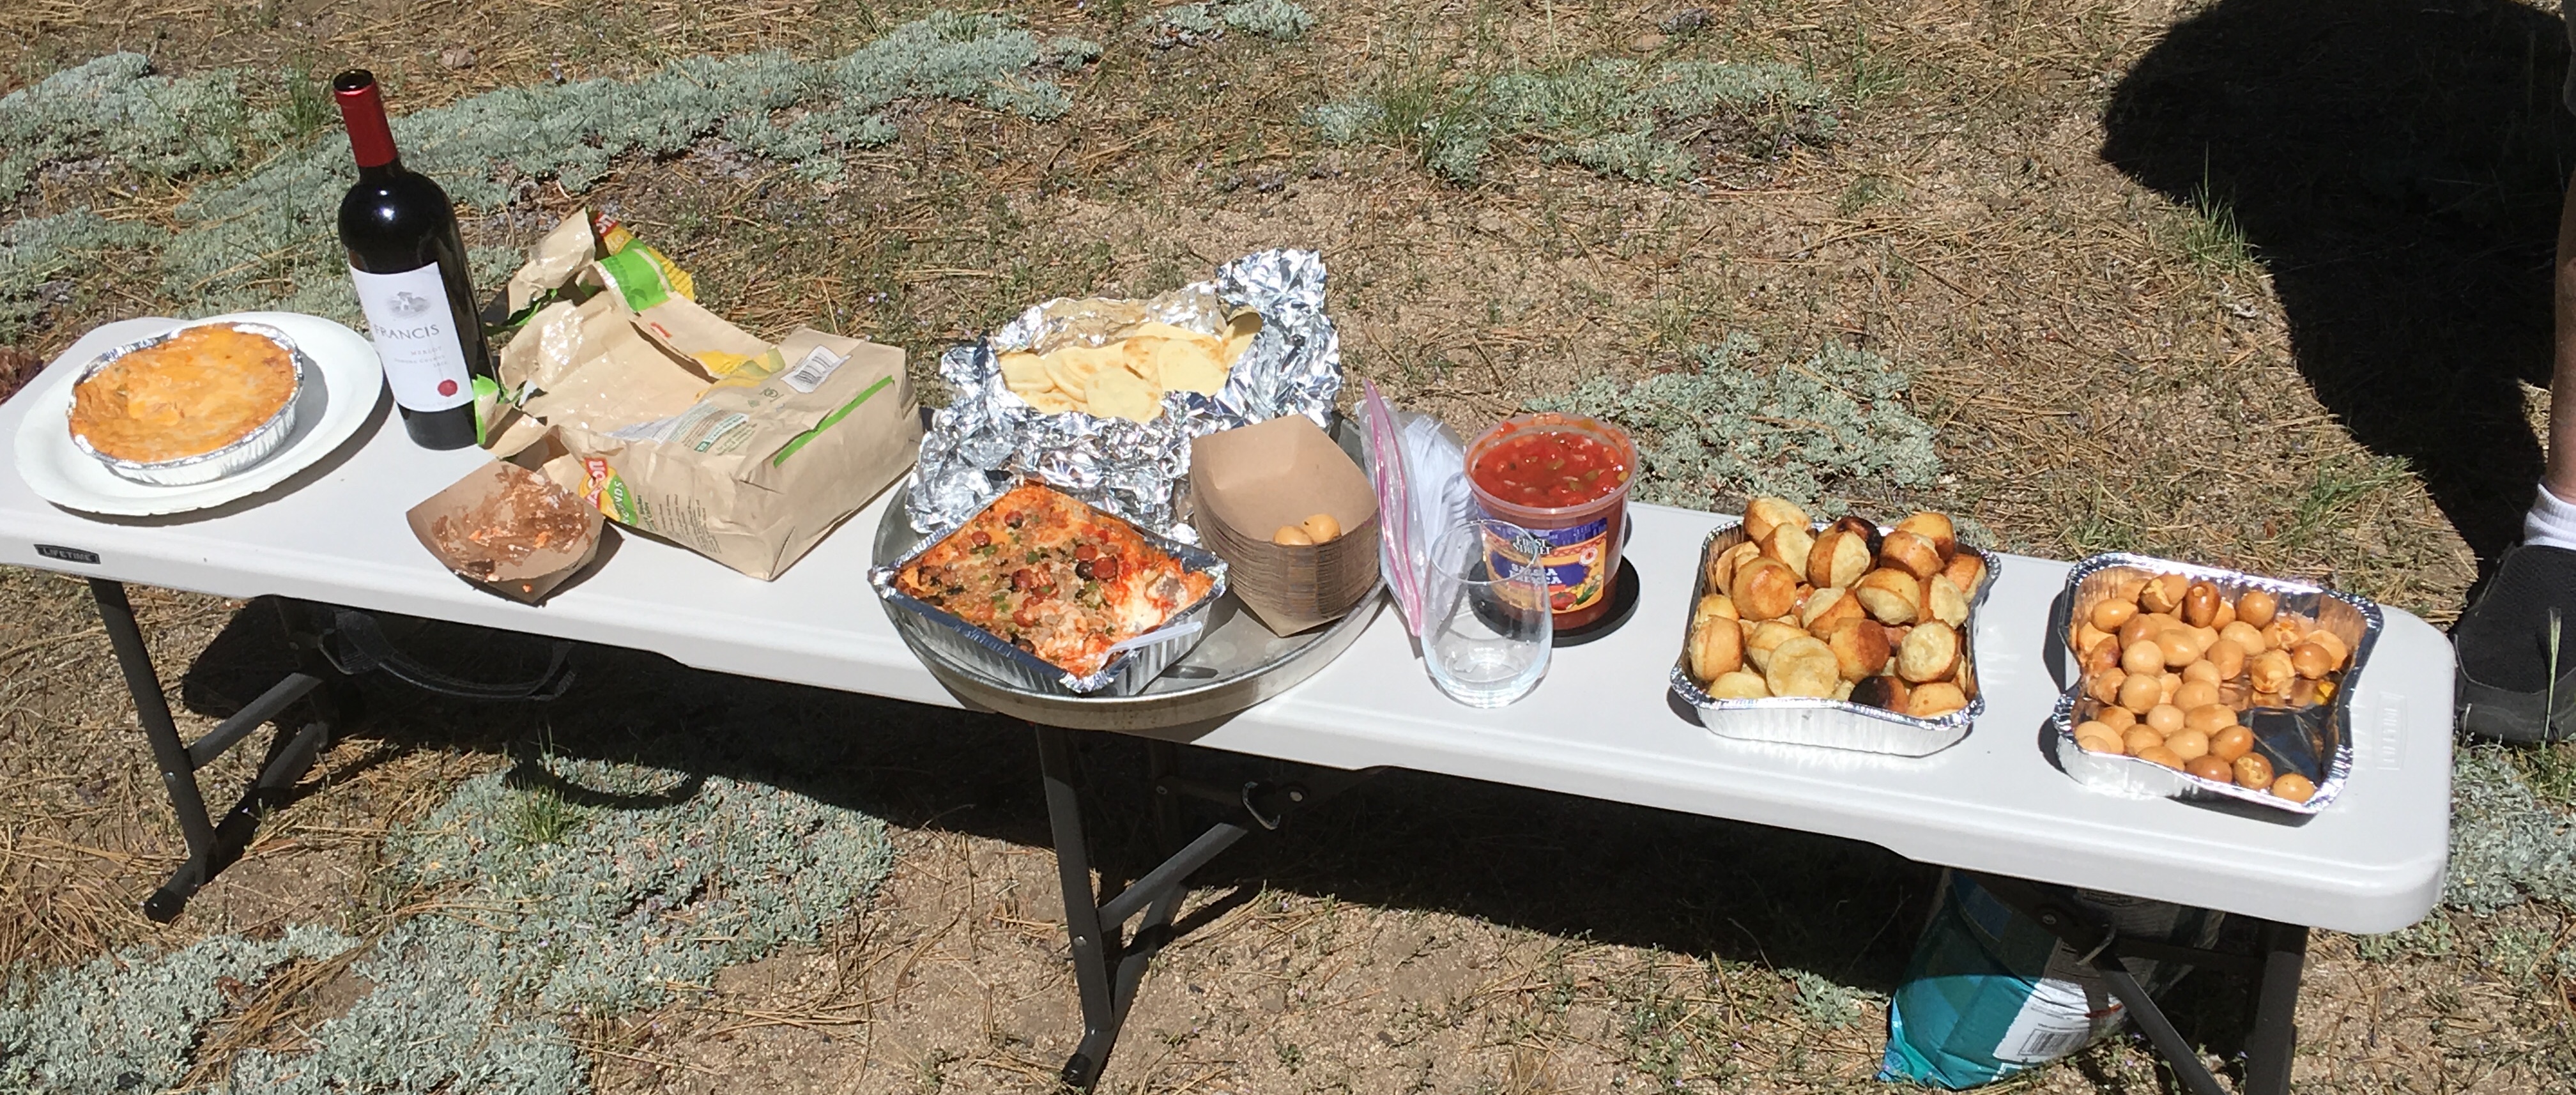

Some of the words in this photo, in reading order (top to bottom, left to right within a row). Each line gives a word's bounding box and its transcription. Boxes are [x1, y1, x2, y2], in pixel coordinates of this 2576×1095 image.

[373, 323, 440, 340] FRANCIS
[42, 547, 93, 562] LIFETIME
[1512, 542, 1552, 555] STRET
